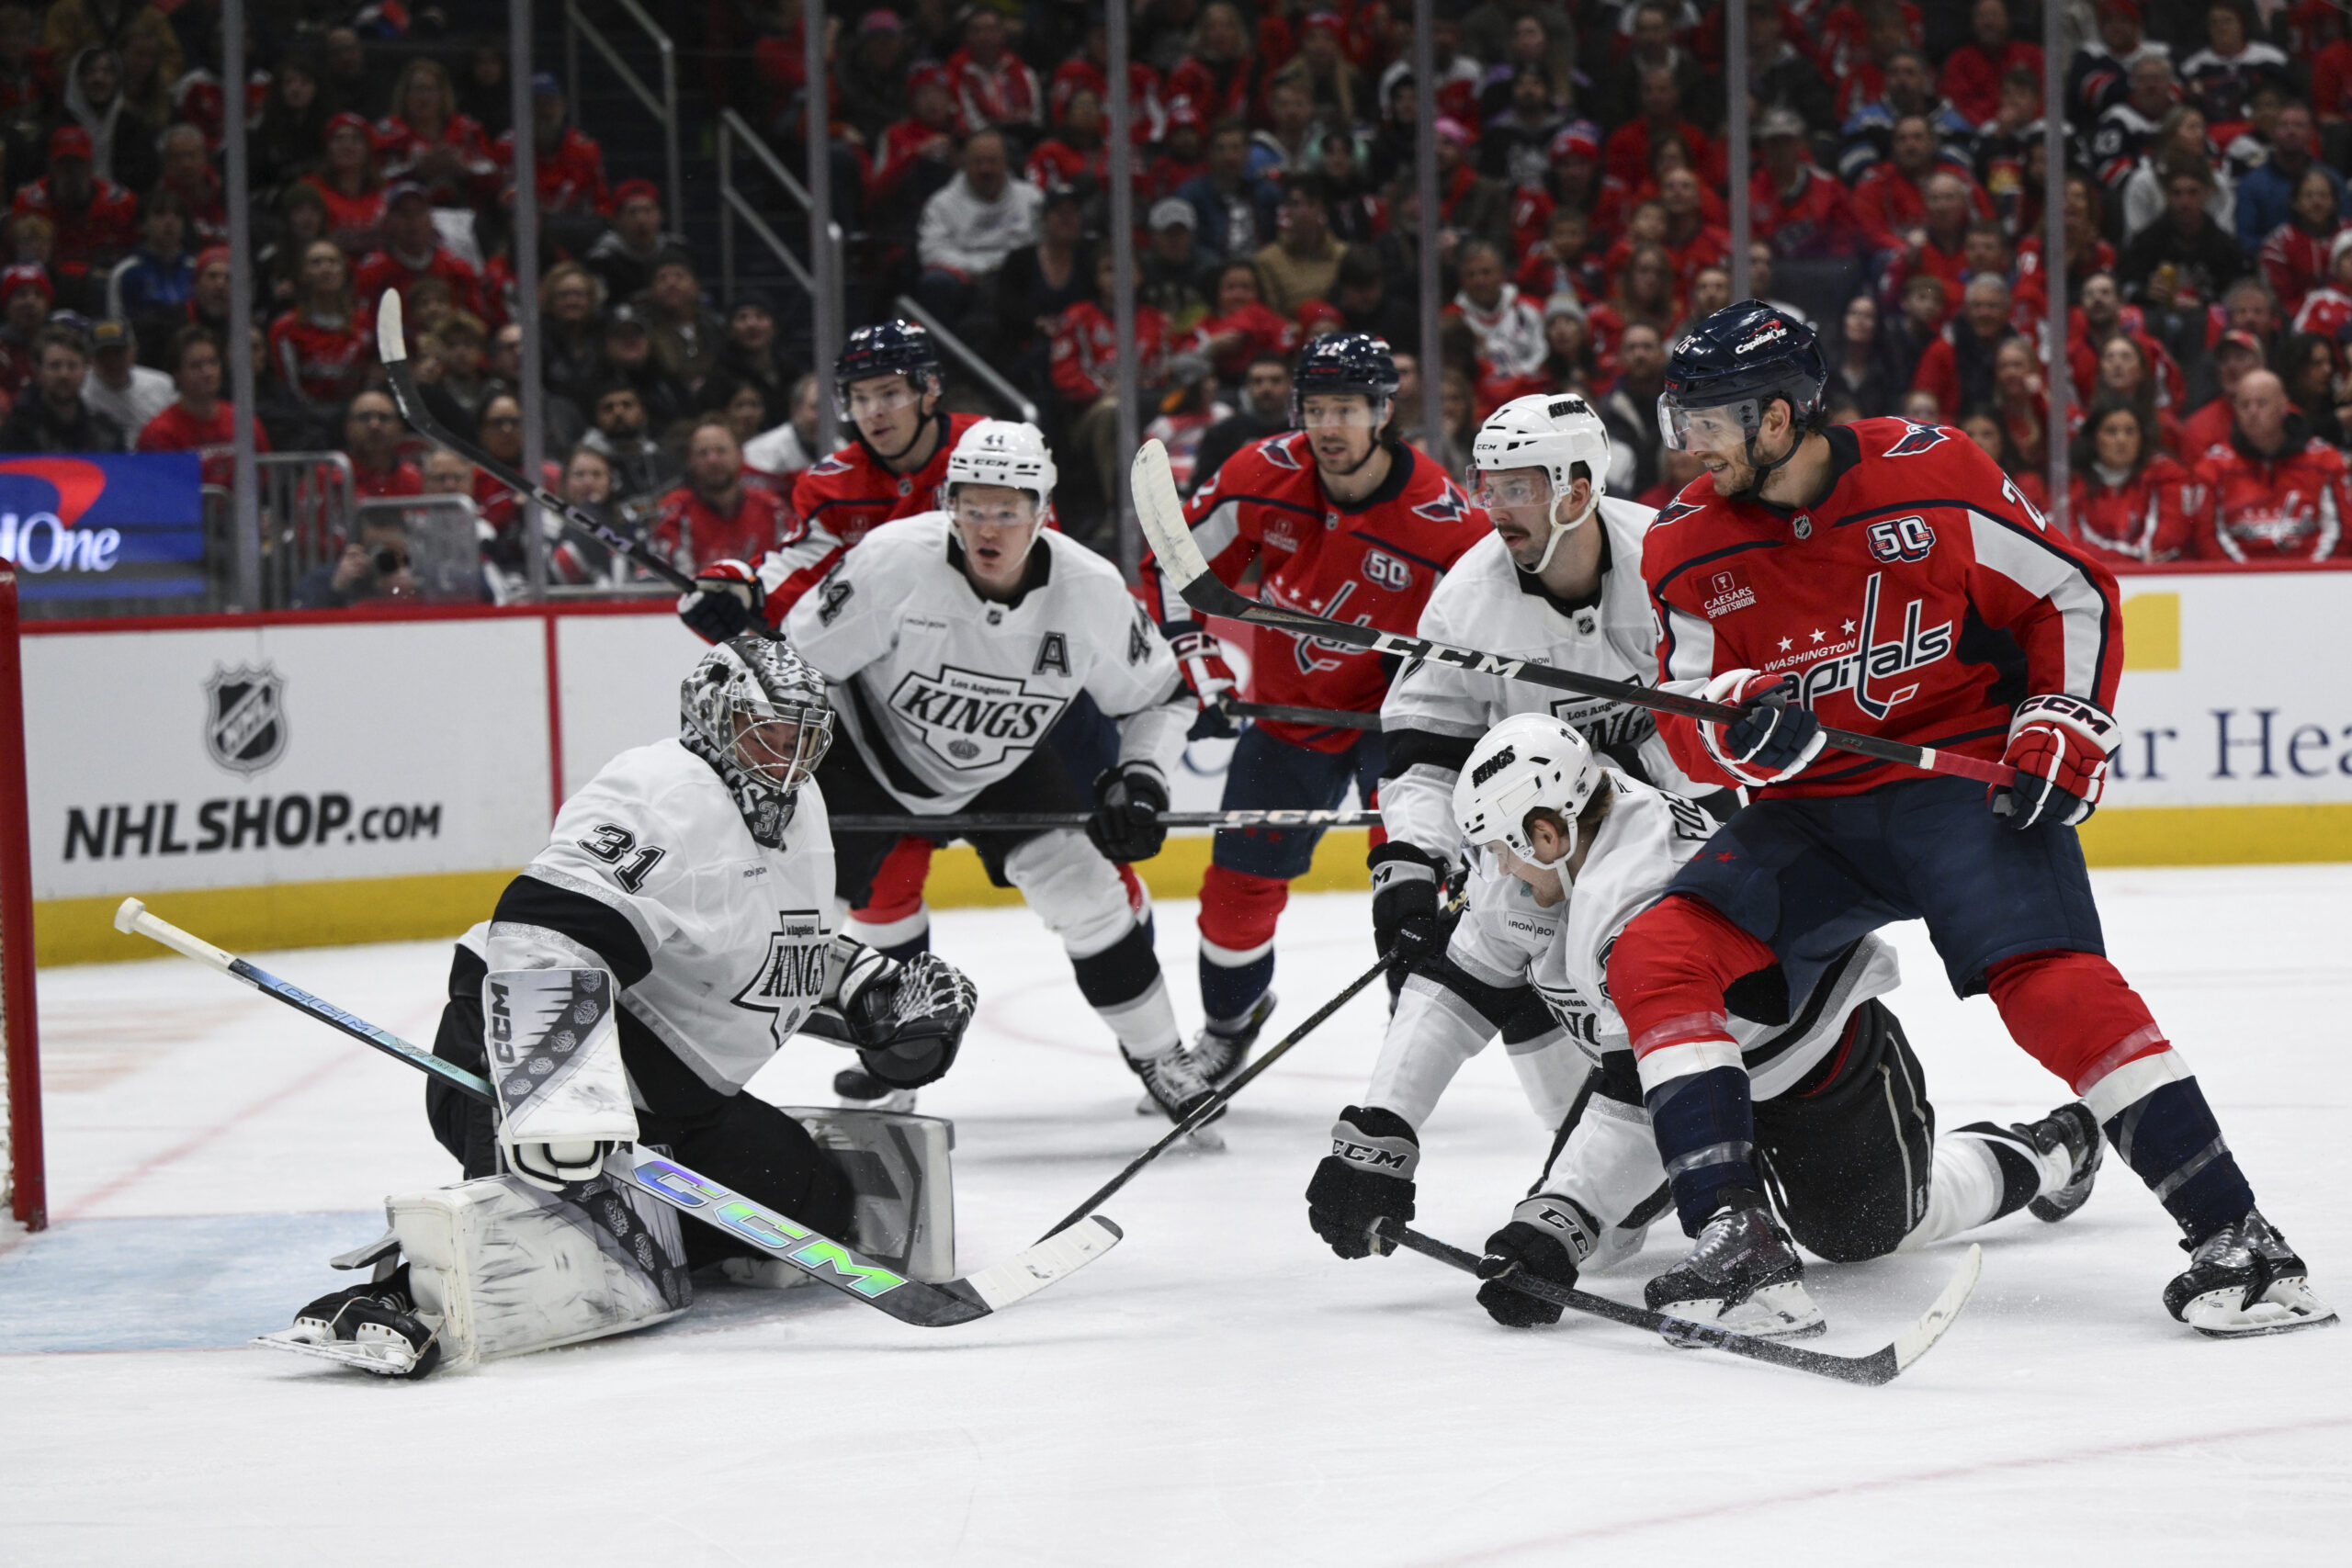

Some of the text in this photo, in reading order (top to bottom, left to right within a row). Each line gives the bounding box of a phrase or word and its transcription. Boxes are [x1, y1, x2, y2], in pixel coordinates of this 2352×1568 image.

[532, 487, 633, 553] CCM
[1703, 586, 1754, 610] CAESARS
[1707, 594, 1758, 620] SPORTSBOOK
[1032, 631, 1072, 678] A
[1372, 633, 1526, 679] CCM
[1764, 637, 1857, 672] WASHINGTON
[950, 678, 969, 690] Los
[902, 685, 1051, 739] KINGS
[1566, 710, 1588, 721] Los
[2016, 695, 2112, 737] CCM
[1225, 809, 1362, 824] CCM
[576, 823, 666, 895] 31
[1400, 928, 1422, 942] CCM
[1508, 920, 1532, 932] IRON
[276, 981, 384, 1037] CCM
[491, 982, 515, 1065] CCM
[1332, 1139, 1408, 1168] CCM
[631, 1160, 910, 1299] CCM
[1538, 1207, 1589, 1263] CC
